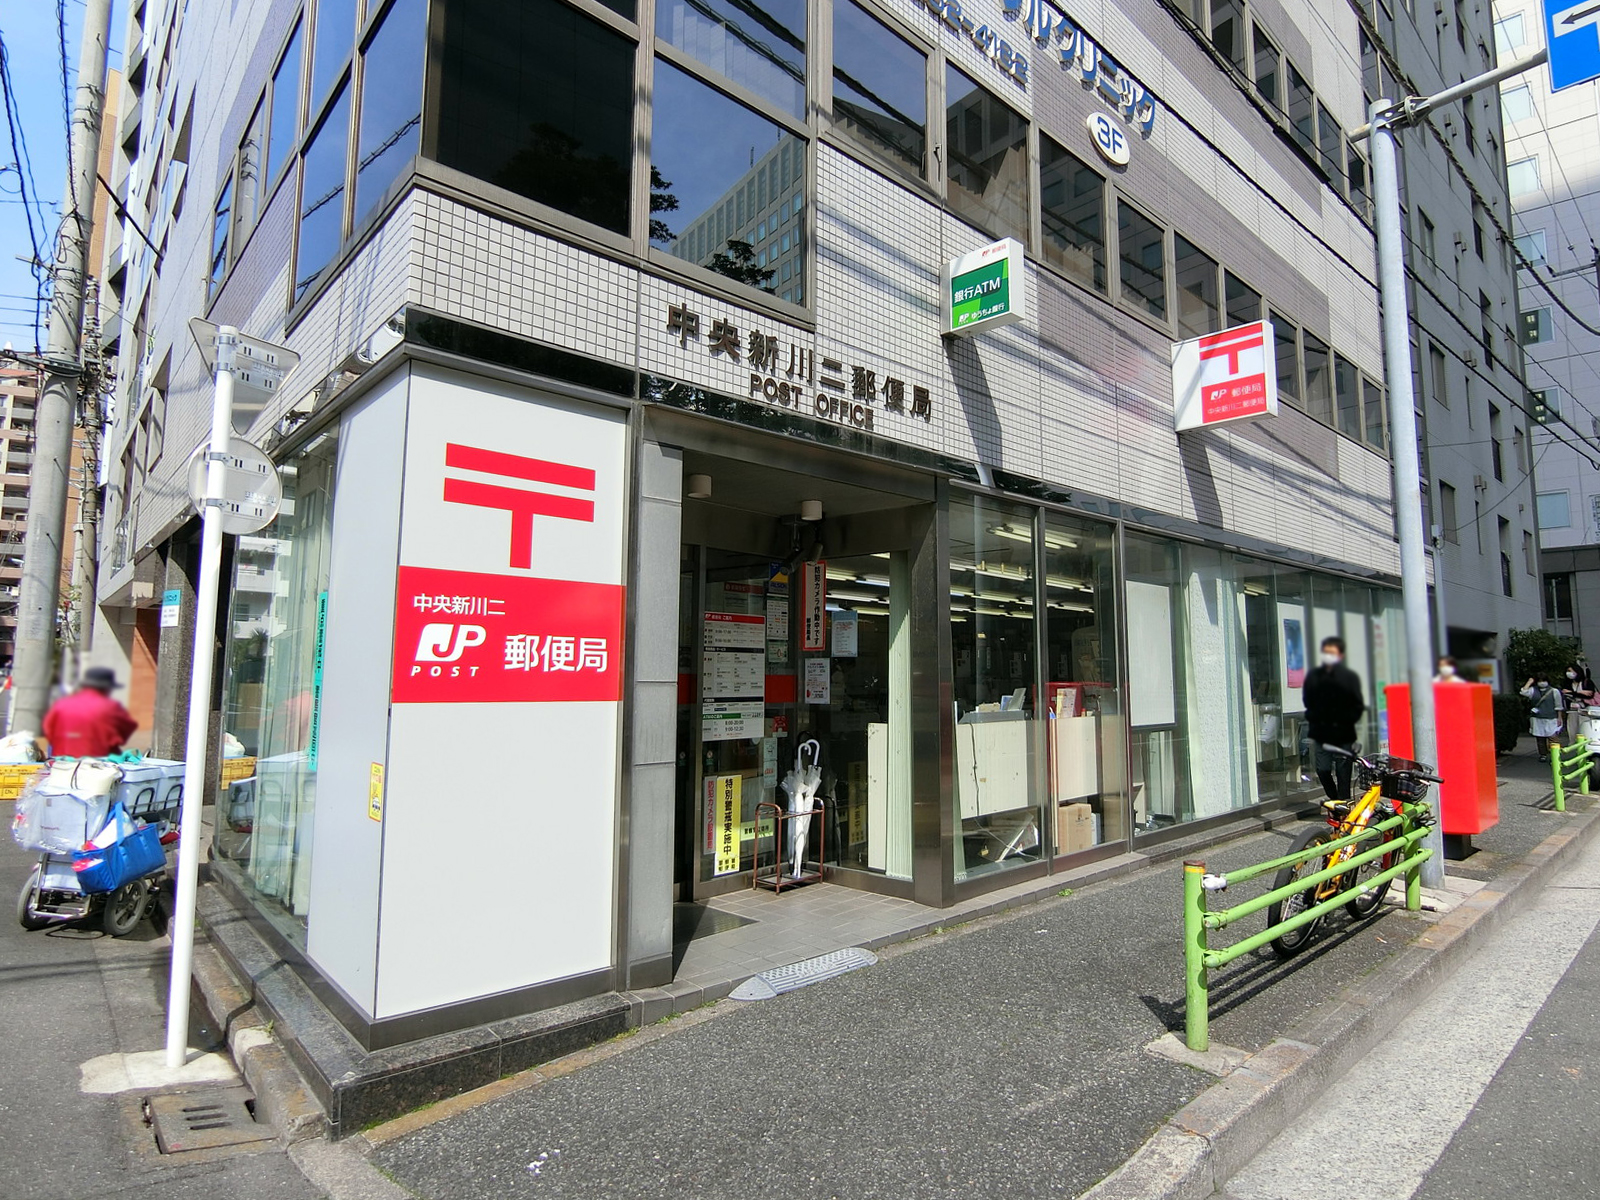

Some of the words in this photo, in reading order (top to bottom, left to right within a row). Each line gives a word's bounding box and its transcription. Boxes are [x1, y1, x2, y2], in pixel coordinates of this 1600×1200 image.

[1096, 115, 1123, 154] 3F
[953, 276, 1002, 303] 銀行ATM
[971, 302, 1005, 319] ゆうちょ銀行
[667, 302, 932, 422] 中央新川二郵便局
[750, 373, 803, 409] POST
[815, 392, 874, 431] OFFICE
[1231, 382, 1262, 397] 郵便局
[413, 593, 506, 616] 中央新川二
[813, 566, 821, 646] 防犯カメラ作動中です
[414, 622, 487, 662] JP
[503, 633, 608, 673] 郵便局
[410, 665, 480, 678] POST
[723, 778, 734, 855] 特別警戒実施中
